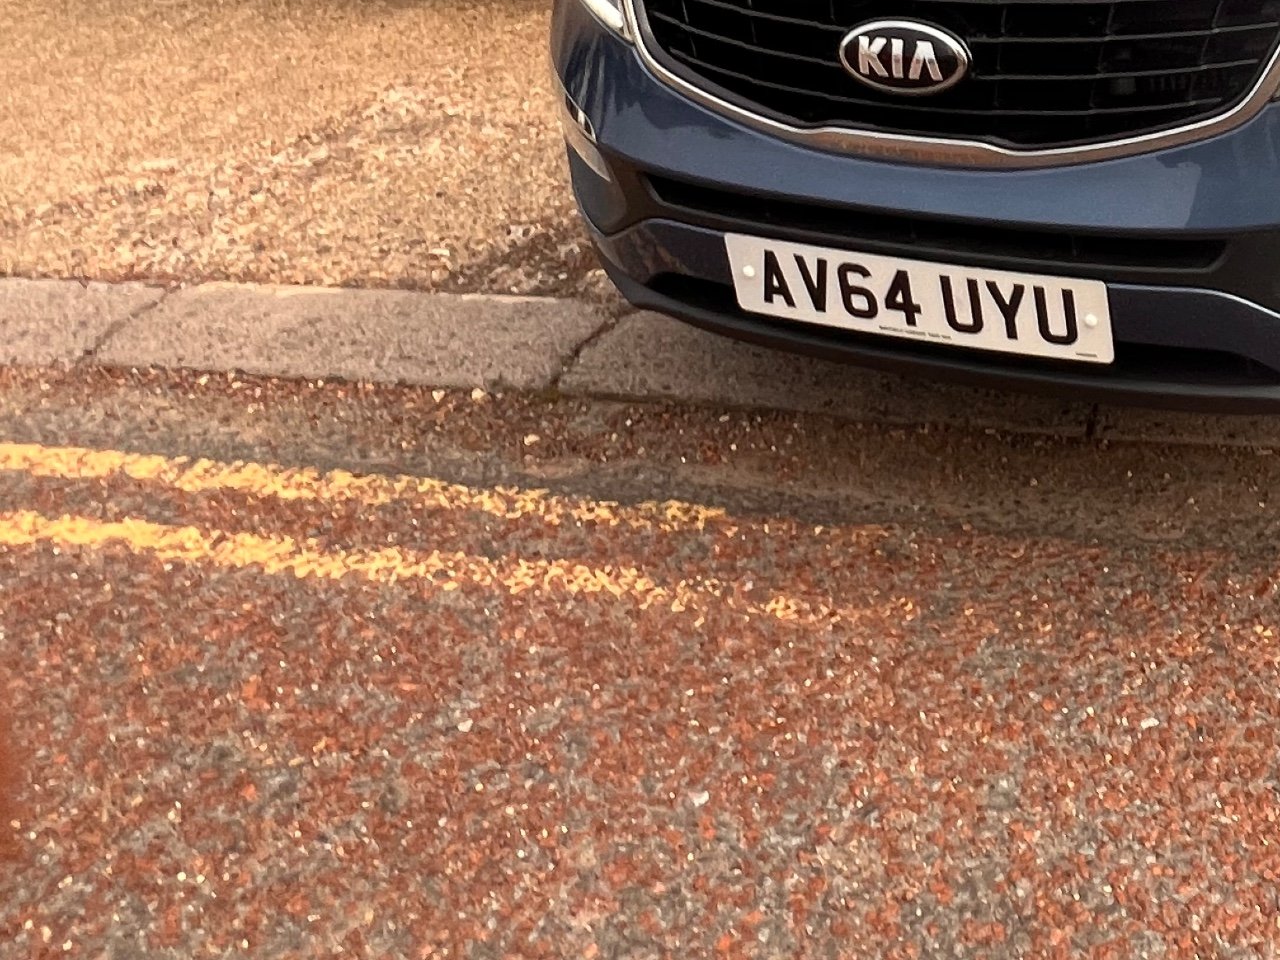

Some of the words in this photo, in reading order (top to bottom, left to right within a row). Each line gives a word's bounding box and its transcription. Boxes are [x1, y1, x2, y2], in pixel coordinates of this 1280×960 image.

[858, 35, 944, 82] KIA
[763, 250, 921, 327] AV64
[938, 274, 1080, 346] UYU
